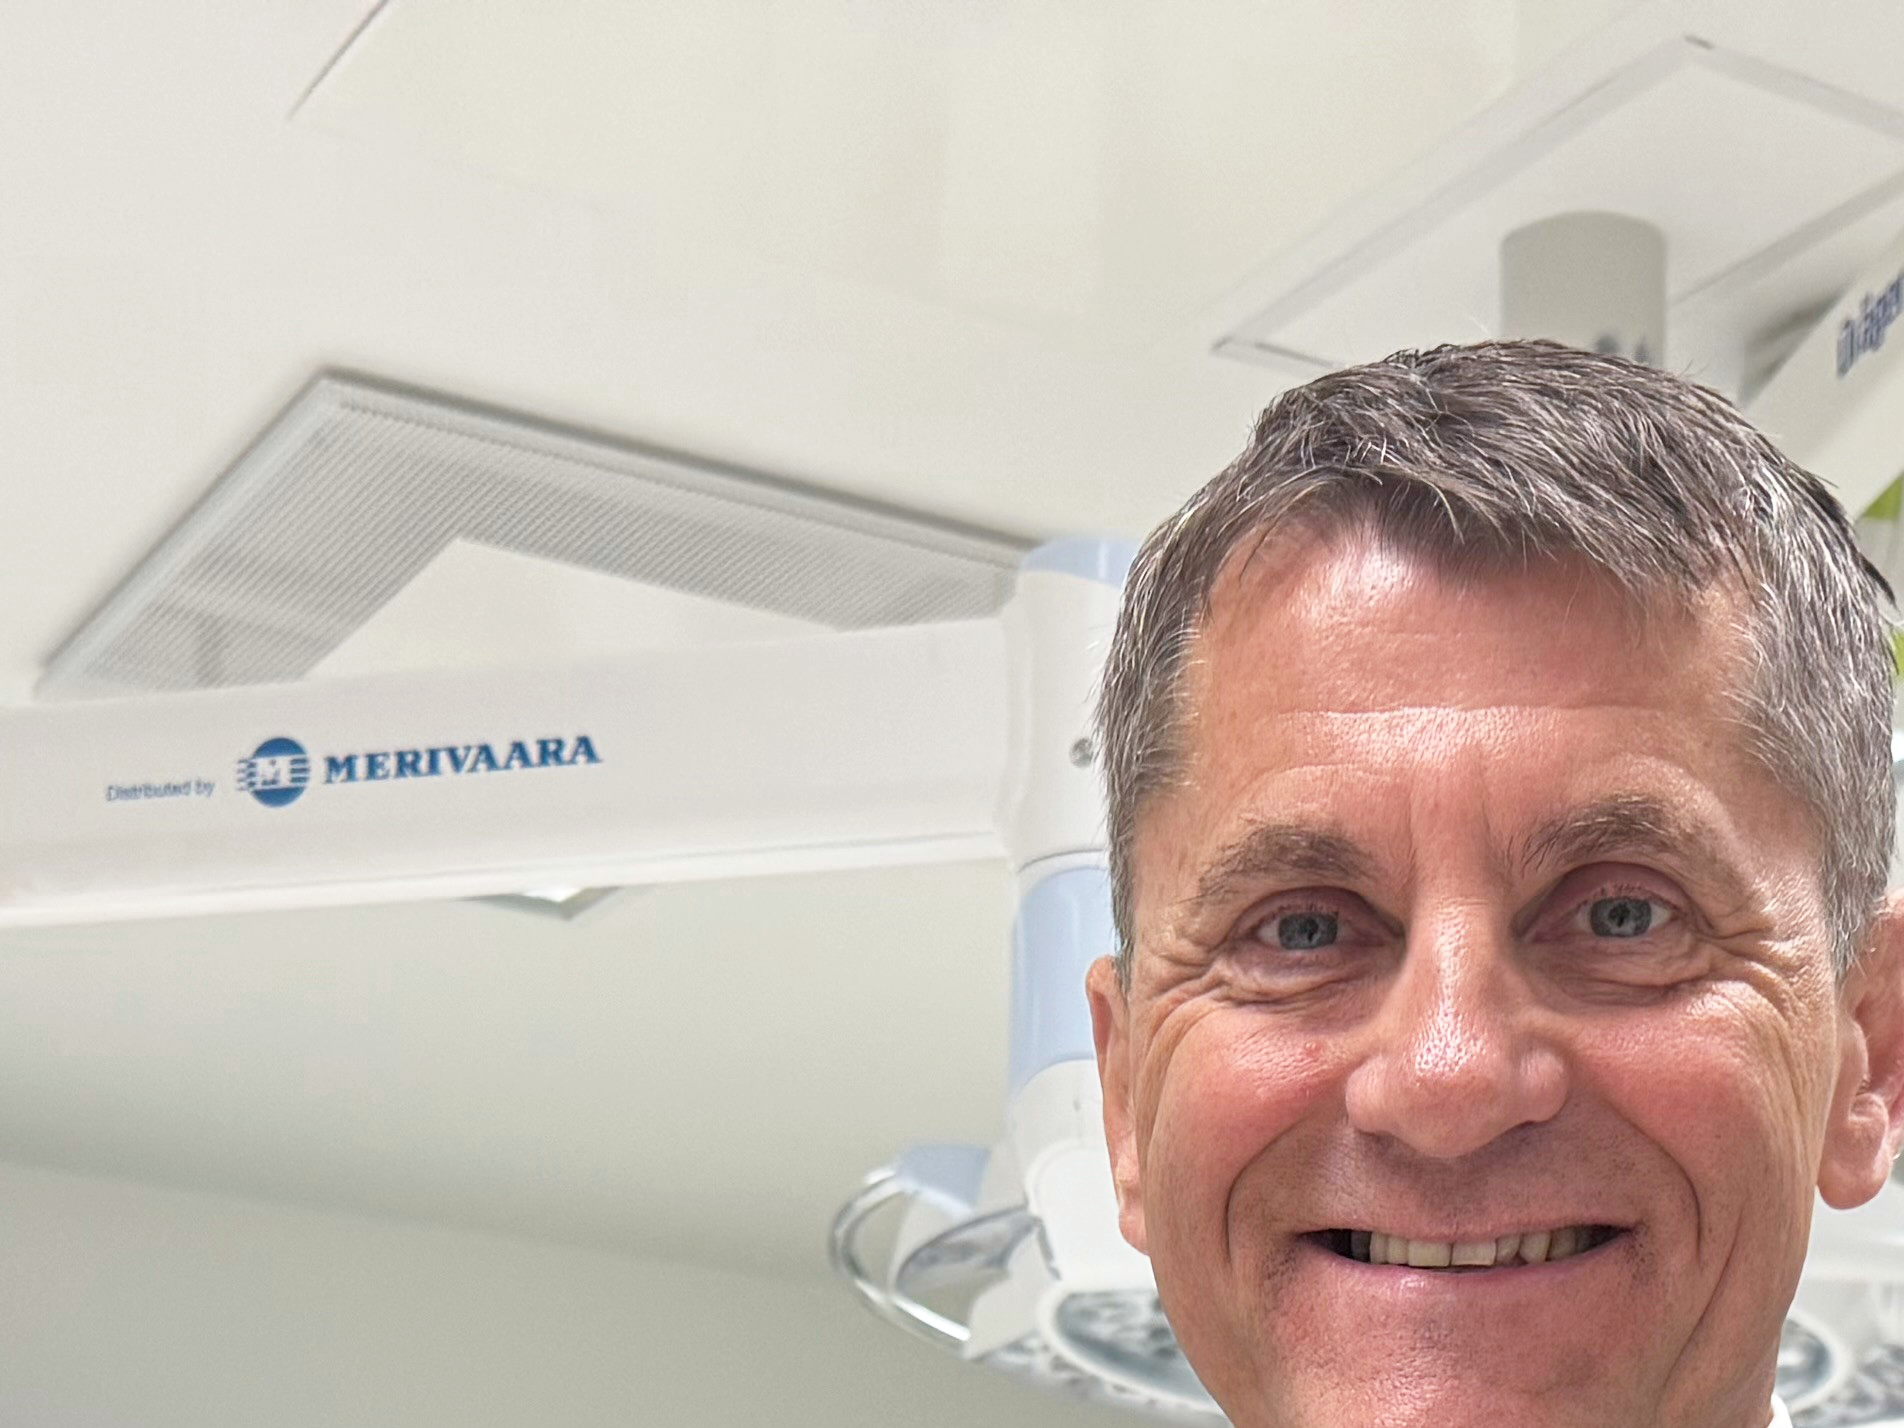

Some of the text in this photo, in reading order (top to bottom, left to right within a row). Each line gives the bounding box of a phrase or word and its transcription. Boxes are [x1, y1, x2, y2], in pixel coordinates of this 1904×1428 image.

[106, 780, 190, 803] Distributed
[194, 779, 216, 800] by
[323, 733, 603, 786] MERIVAARA
